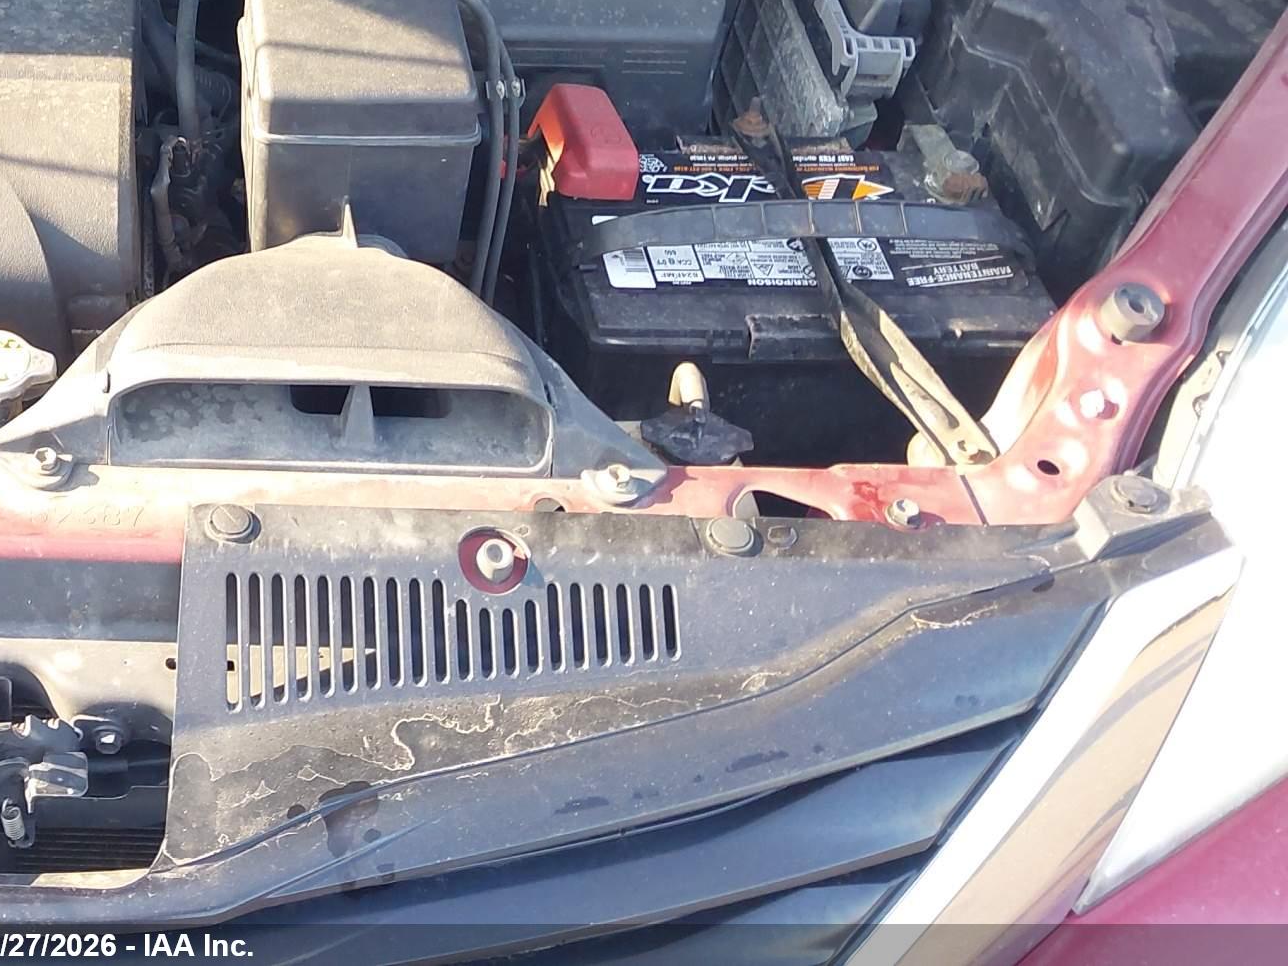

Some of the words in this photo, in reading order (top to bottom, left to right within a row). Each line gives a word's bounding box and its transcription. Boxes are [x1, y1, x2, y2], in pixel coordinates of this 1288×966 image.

[932, 262, 979, 275] BATTERY
[747, 278, 817, 287] GER/POISON
[906, 266, 1012, 287] MAINTENANCE-FREE
